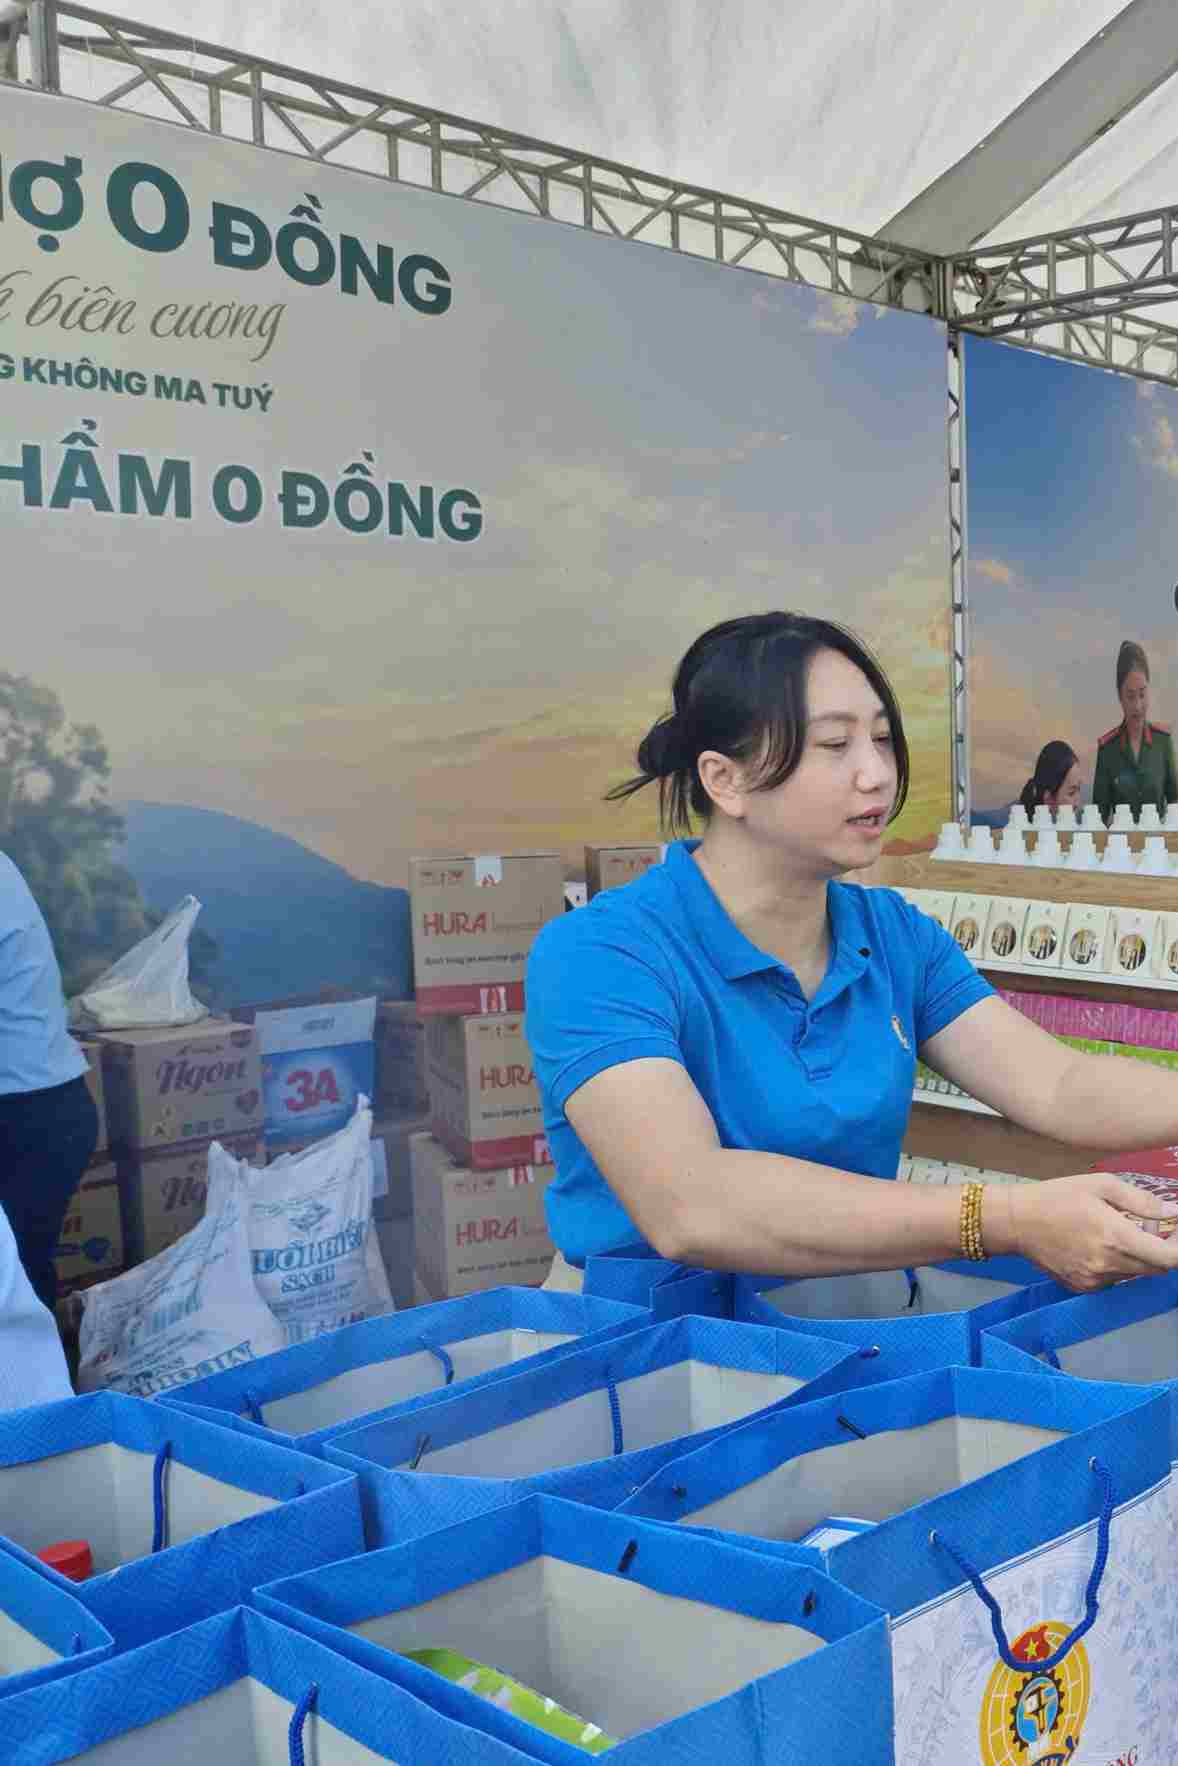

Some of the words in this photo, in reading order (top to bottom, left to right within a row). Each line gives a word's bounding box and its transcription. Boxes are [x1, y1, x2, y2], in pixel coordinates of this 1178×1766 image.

[209, 192, 453, 316] ĐỒNG
[25, 275, 137, 335] biên
[150, 300, 288, 362] cương
[22, 357, 147, 396] KHÔNG
[154, 374, 207, 405] MA
[212, 382, 273, 413] TUÝ
[278, 450, 483, 542] ĐỒNG
[423, 911, 487, 937] HURA
[285, 1068, 340, 1112] 3A
[455, 1216, 519, 1249] HURA
